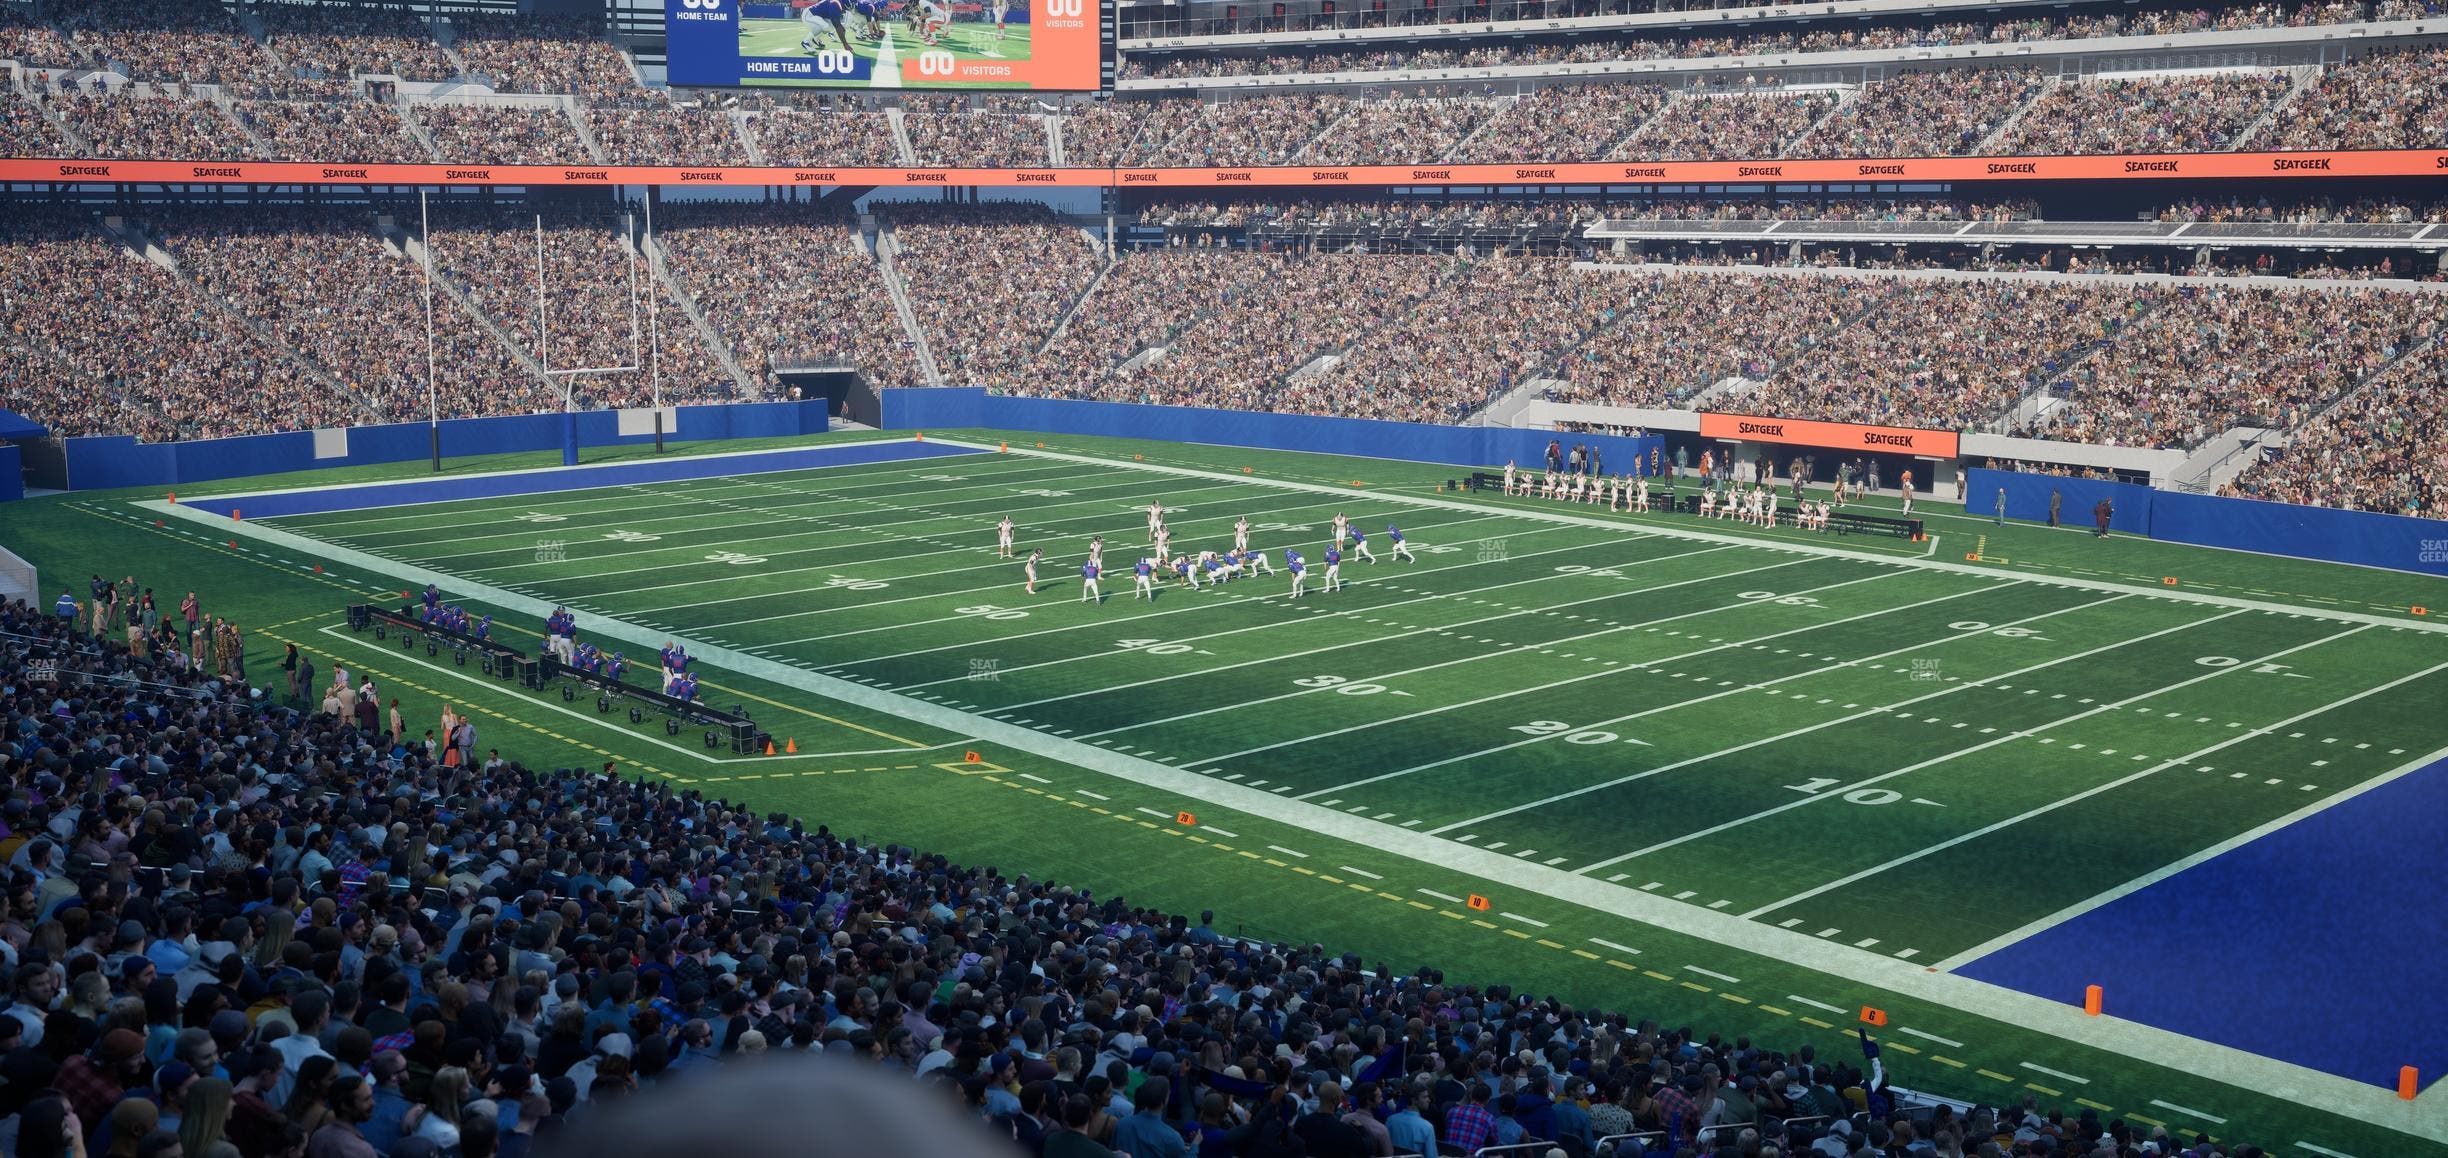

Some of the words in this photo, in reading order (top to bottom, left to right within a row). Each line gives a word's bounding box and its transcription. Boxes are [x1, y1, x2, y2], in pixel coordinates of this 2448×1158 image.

[676, 12, 701, 21] HOME
[703, 13, 727, 21] TEAM
[1046, 20, 1084, 28] VISITORS
[747, 62, 778, 72] HOME
[781, 63, 810, 73] TEAM
[818, 50, 853, 74] 00
[920, 51, 954, 75] 00
[962, 66, 1011, 75] VISITORS
[1988, 163, 2036, 173] SEATGEEK
[2125, 161, 2178, 172] SEATGEEK
[2273, 158, 2331, 170] SEATGEEK
[60, 165, 110, 176] SEATGEEK
[193, 167, 241, 177] SEATGEEK
[322, 168, 368, 178] SEATGEEK
[446, 170, 490, 179] SEATGEEK
[1413, 171, 1450, 179] SEATGEEK
[1516, 169, 1555, 178] SEATGEEK
[1625, 168, 1665, 177] SEATGEEK
[1738, 167, 1782, 176] SEATGEEK
[1859, 165, 1904, 175] SEATGEEK
[565, 171, 608, 180] SEATGEEK
[680, 172, 722, 181] SEATGEEK
[795, 172, 836, 181] SEATGEEK
[906, 173, 946, 182] SEATGEEK
[1016, 173, 1056, 182] SEATGEEK
[1124, 174, 1157, 182] SEATGEEK
[1216, 172, 1251, 181] SEATGEEK
[1313, 172, 1349, 180] SEATGEEK
[1739, 422, 1784, 436] SEATGEEK
[1864, 432, 1913, 447] SEATGEEK
[954, 605, 1030, 620] 50
[1113, 638, 1194, 655] 40
[1293, 675, 1388, 695] 30
[1508, 720, 1619, 745] 20
[1782, 777, 1903, 805] 10
[1473, 898, 1482, 906] 10
[1869, 1010, 1876, 1020] G
